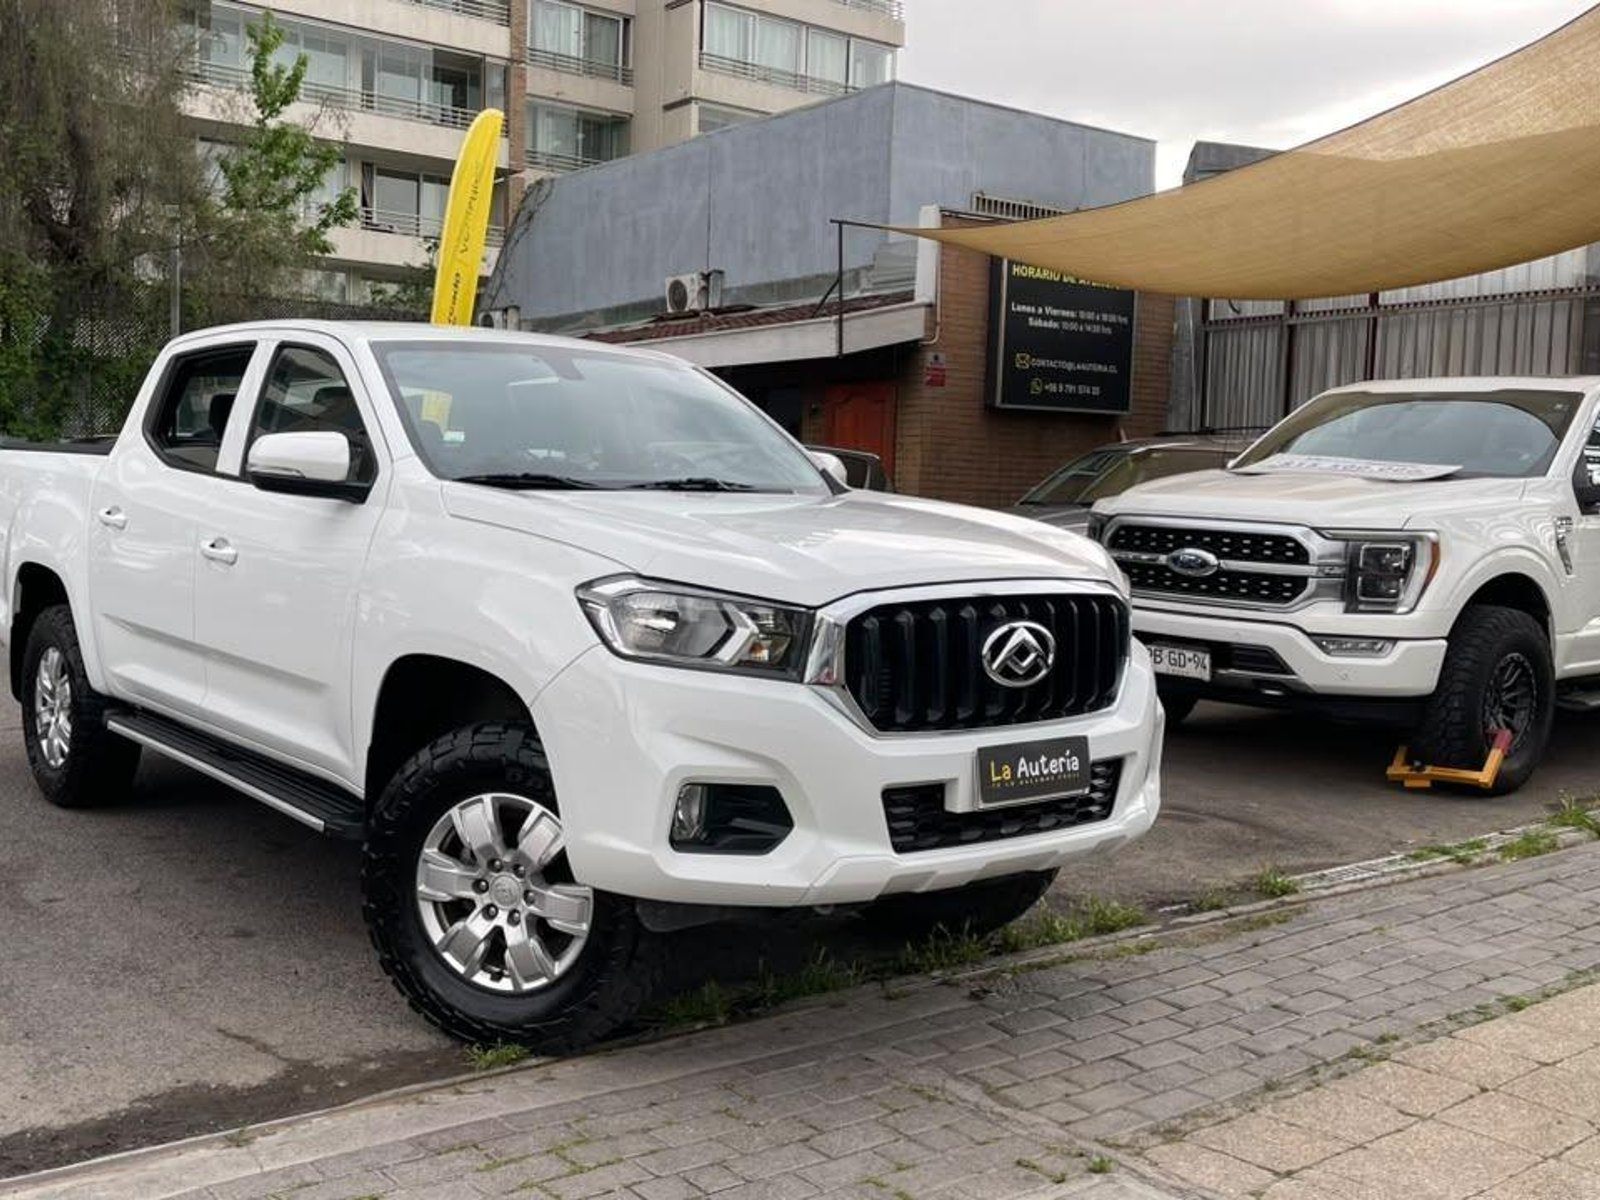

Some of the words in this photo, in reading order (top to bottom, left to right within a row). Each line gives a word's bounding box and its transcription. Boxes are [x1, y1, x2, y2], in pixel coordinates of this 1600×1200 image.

[1011, 301, 1036, 314] Lunes
[990, 760, 1012, 782] La
[1017, 749, 1080, 779] Autería
